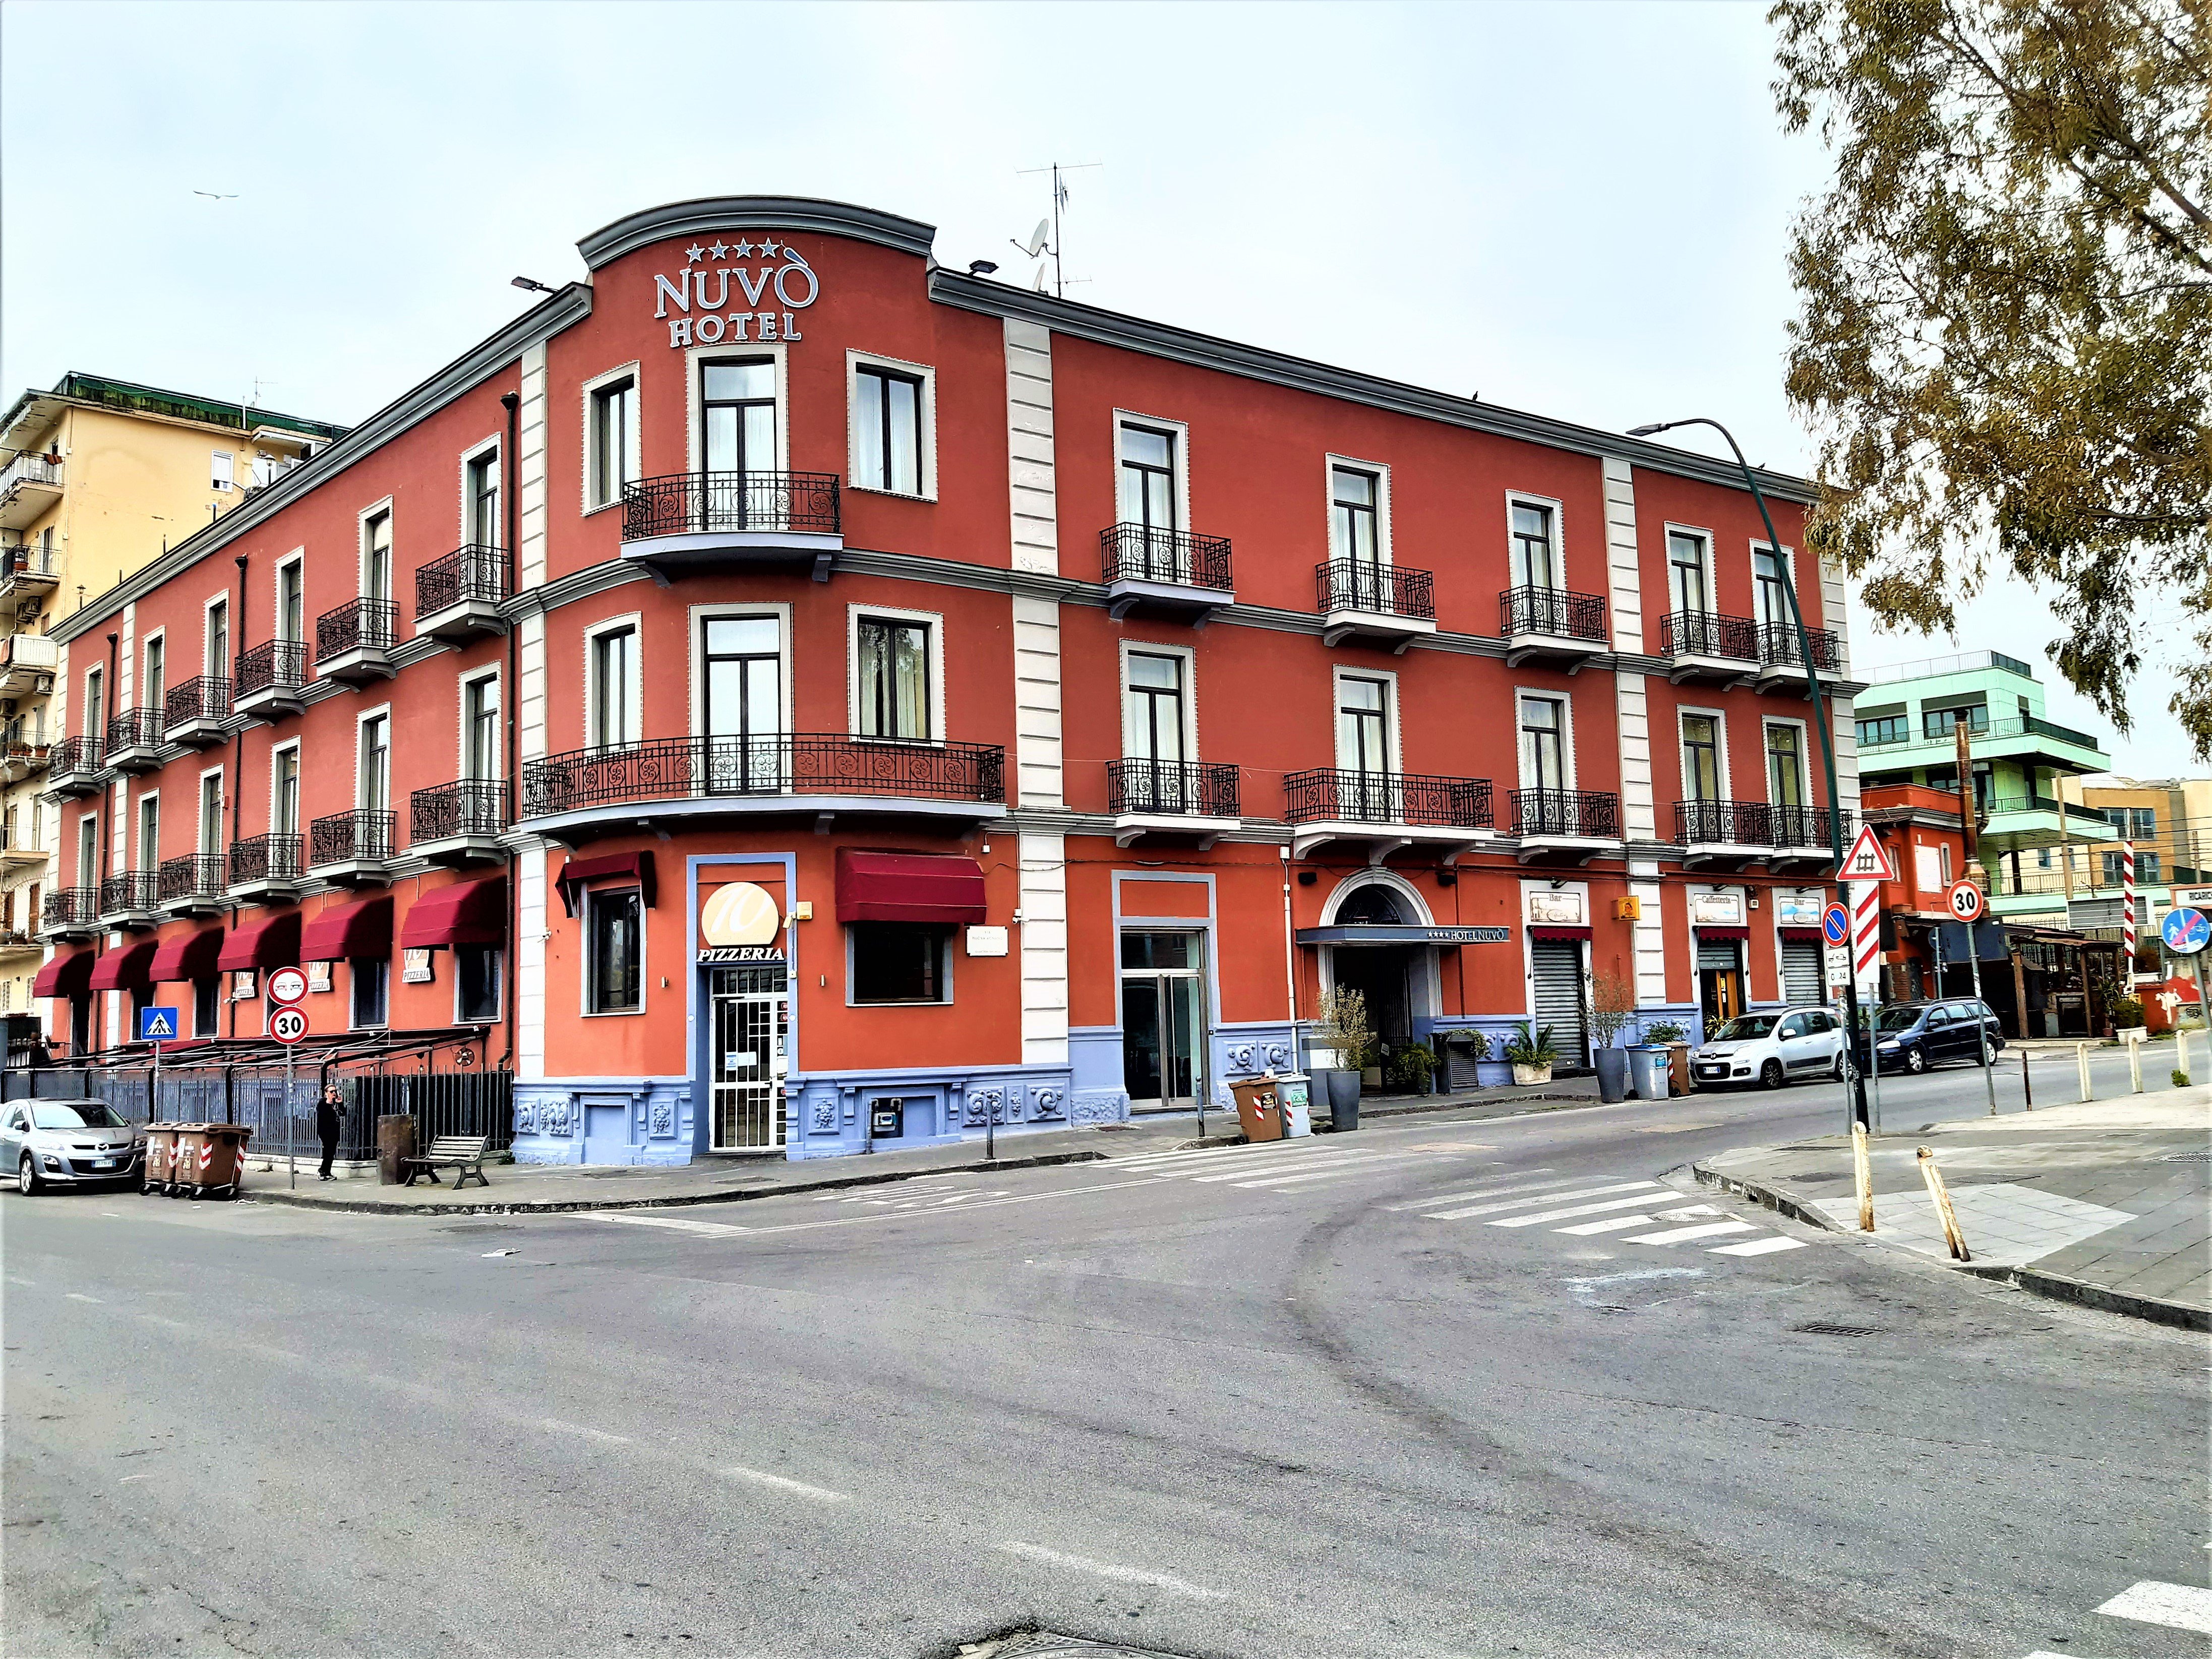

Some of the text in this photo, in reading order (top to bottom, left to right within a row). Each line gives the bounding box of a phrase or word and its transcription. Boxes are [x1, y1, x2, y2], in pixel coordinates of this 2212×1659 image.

[654, 247, 819, 318] NUVÒ
[669, 312, 802, 348] HOTEL
[1702, 895, 1731, 903] Caffetteria
[1955, 891, 1975, 911] 30
[1451, 928, 1504, 940] HOTEL NUVÒ
[697, 948, 785, 962] PIZZERIA
[403, 970, 429, 980] PIZZERIA
[278, 1016, 302, 1034] 30
